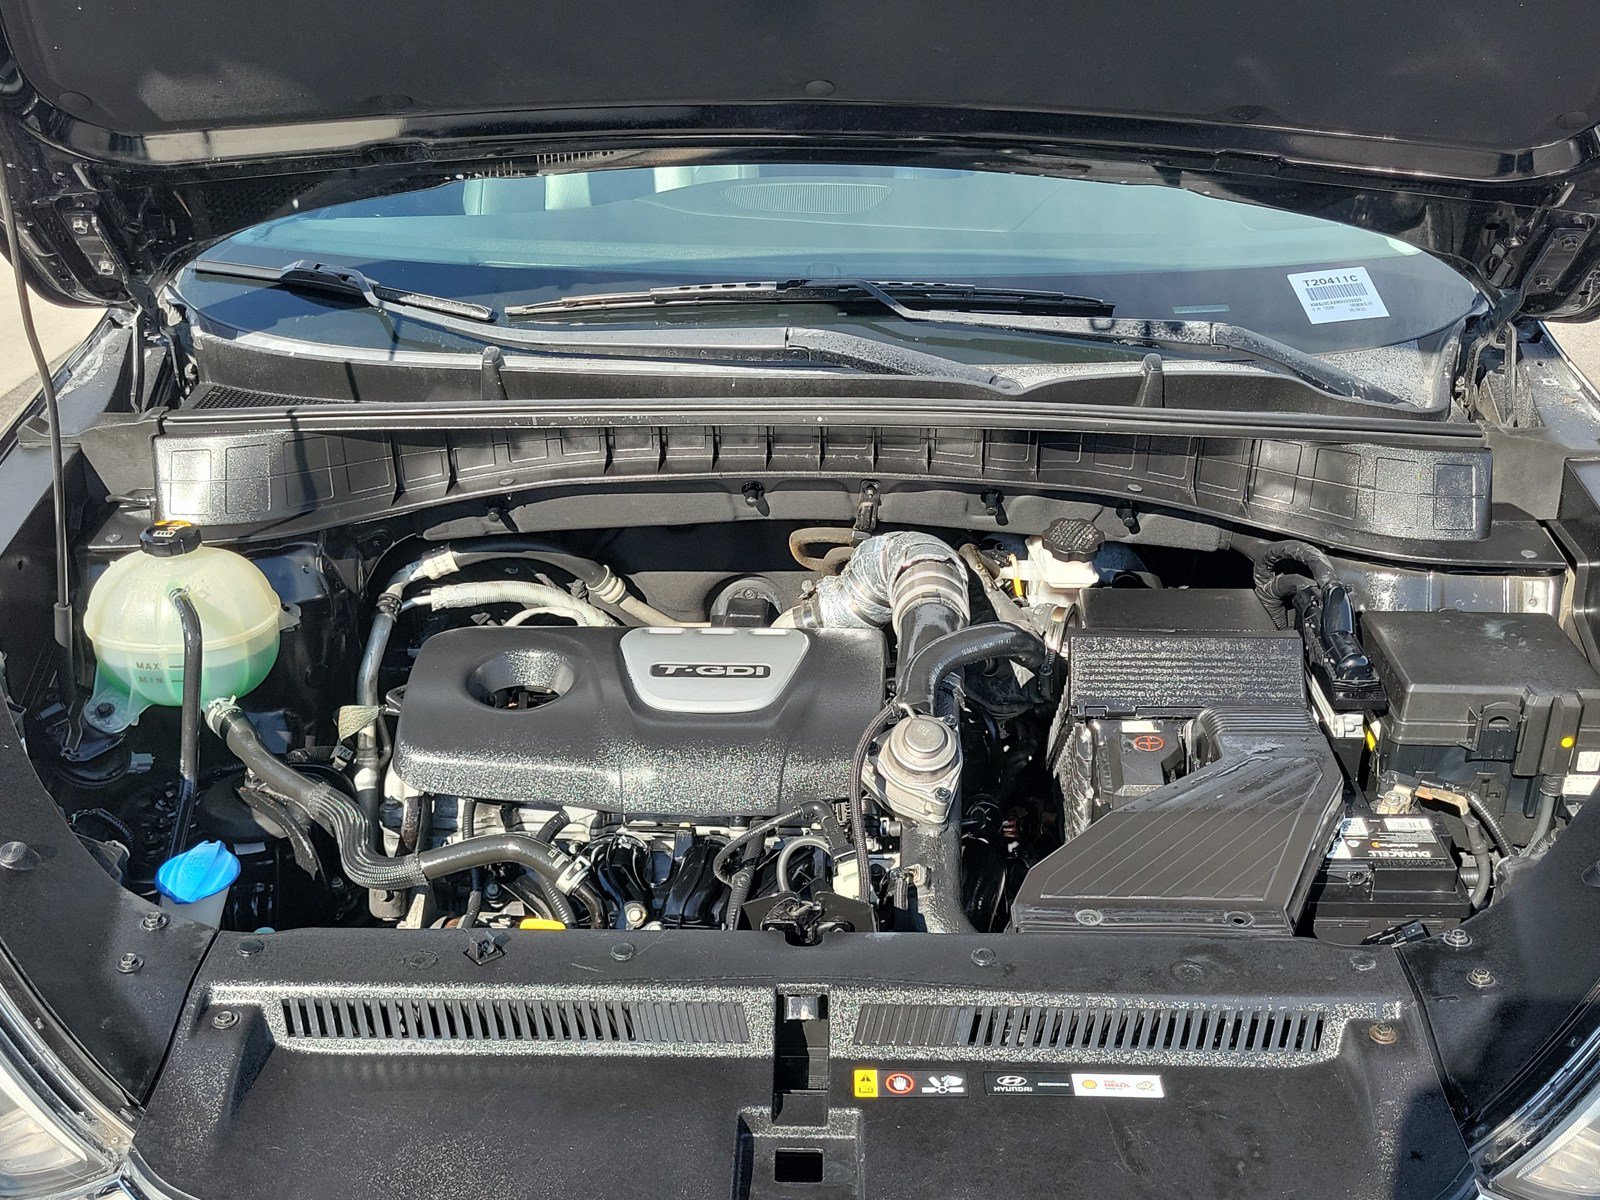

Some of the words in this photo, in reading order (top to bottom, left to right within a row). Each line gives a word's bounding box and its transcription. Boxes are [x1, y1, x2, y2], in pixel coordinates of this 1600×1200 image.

[1303, 275, 1358, 287] T20411C
[136, 662, 159, 670] MAX
[1368, 850, 1432, 858] DURACELL
